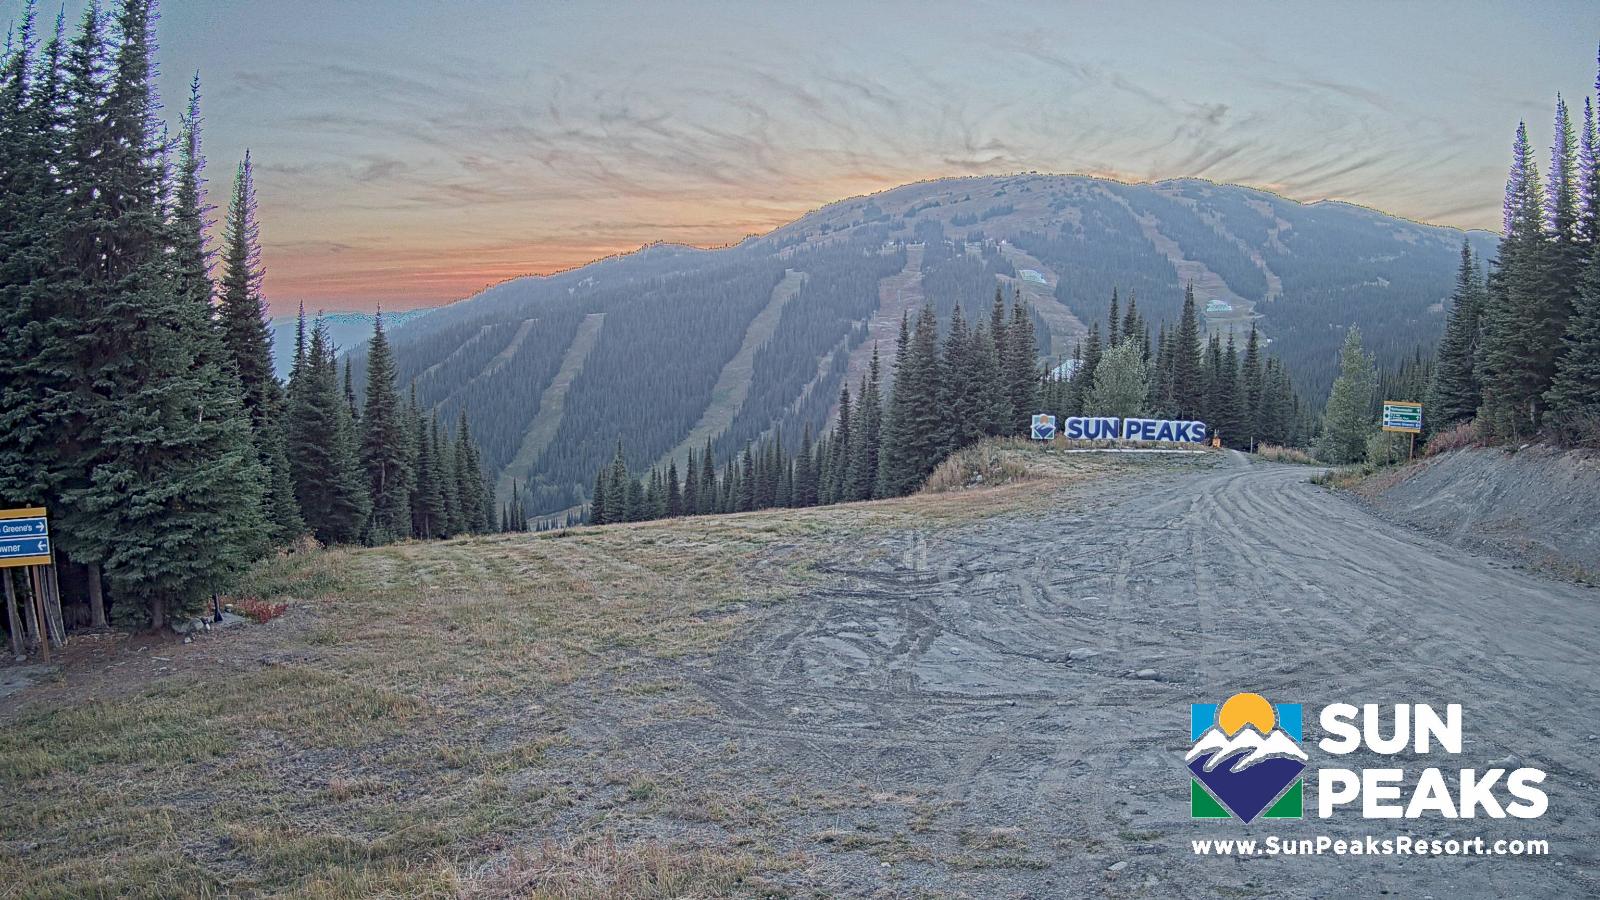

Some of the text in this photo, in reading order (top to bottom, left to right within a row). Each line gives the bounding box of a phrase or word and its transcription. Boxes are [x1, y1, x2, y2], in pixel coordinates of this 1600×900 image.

[1067, 419, 1206, 443] SUN PEAKS
[2, 524, 33, 533] Greene's
